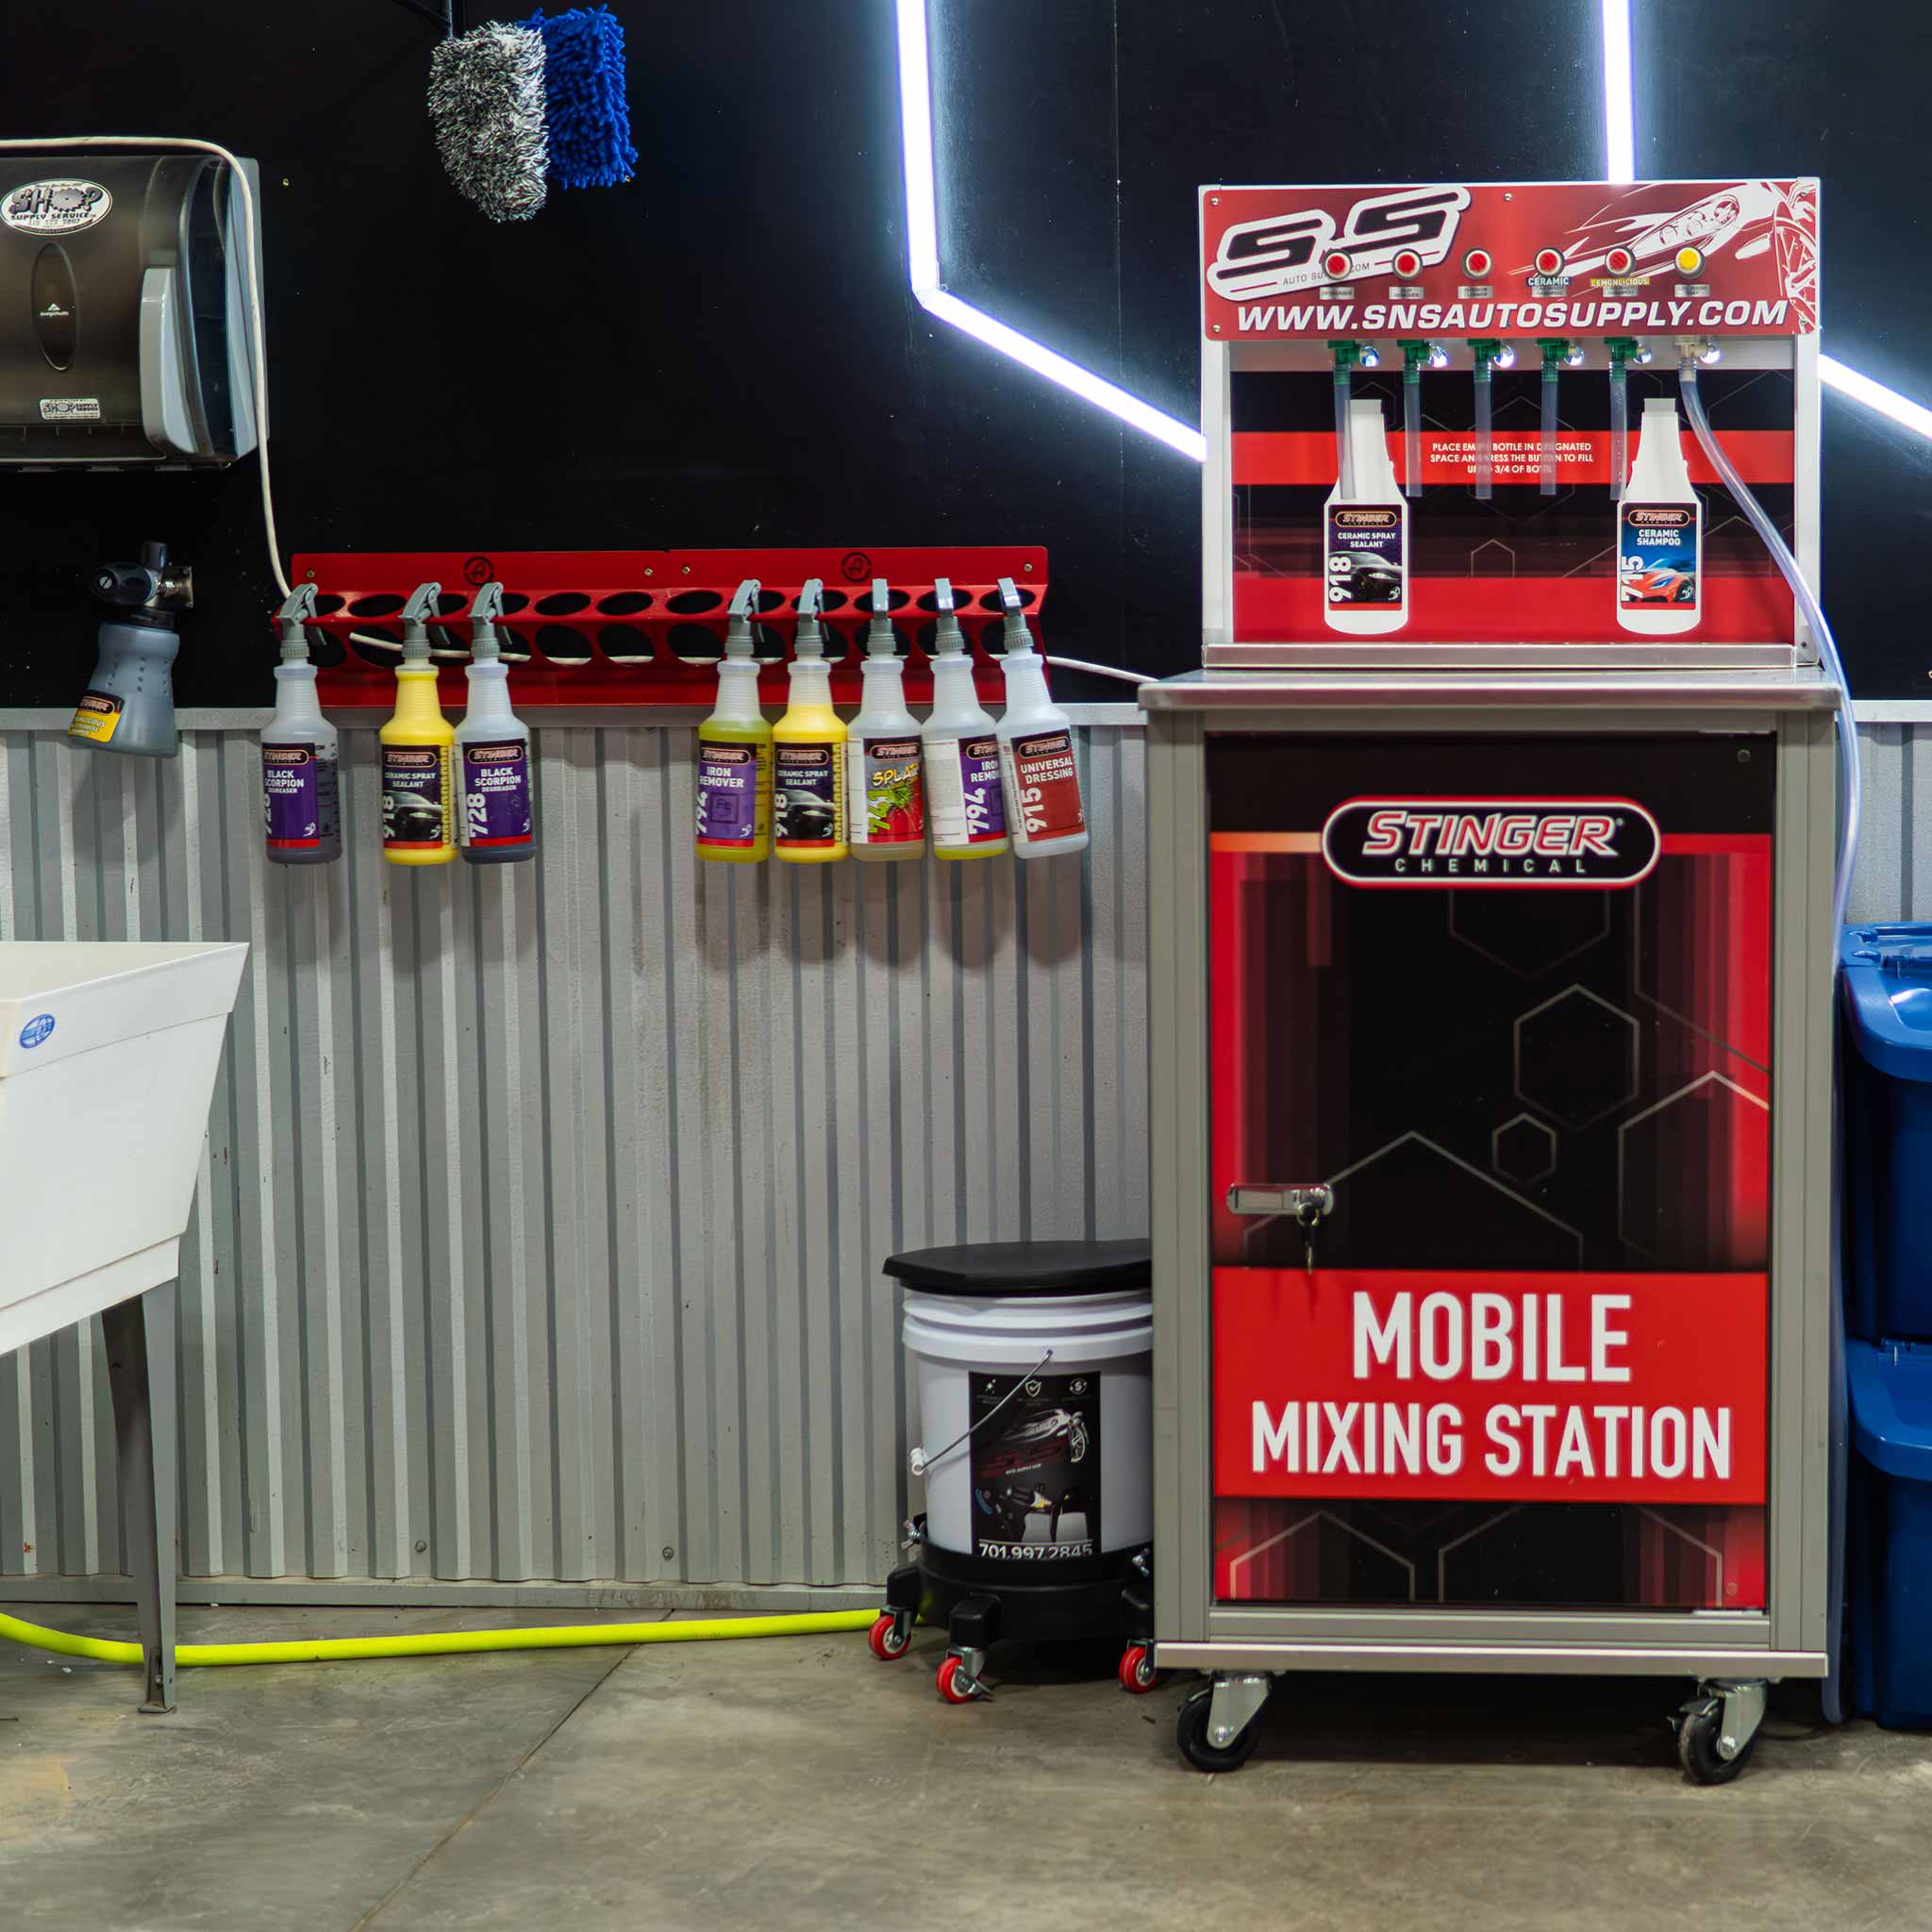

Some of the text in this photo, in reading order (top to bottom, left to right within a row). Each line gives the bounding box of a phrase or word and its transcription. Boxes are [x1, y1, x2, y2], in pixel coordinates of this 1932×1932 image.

[1283, 275, 1307, 286] AUTO
[1528, 277, 1569, 286] CERAMIC
[1591, 278, 1647, 287] LEMONLICIOUS
[1238, 300, 1789, 330] WWW.SNSAUTOSUPPLY.COM
[1432, 442, 1459, 452] PLACE
[1493, 442, 1522, 451] BOTTLE
[1524, 442, 1534, 451] IN
[1537, 442, 1591, 451] DGNATED
[1578, 454, 1593, 462] FILL
[1495, 465, 1509, 474] 3/4
[1511, 465, 1524, 474] OF
[1343, 513, 1390, 523] STINGER
[1636, 512, 1683, 522] STINGER
[1329, 557, 1351, 602] 918
[1621, 556, 1643, 602] 715
[1025, 739, 1067, 754] STINGER
[474, 749, 519, 759] STINGER
[1020, 756, 1073, 774] UNIVERSAL
[267, 770, 294, 778] BLACK
[480, 767, 513, 777] BLACK
[706, 766, 731, 777] IRON
[971, 770, 1000, 782] REMO
[1025, 767, 1073, 784] DRESSING
[264, 778, 304, 788] SCORPION
[475, 775, 522, 787] SCORPION
[699, 775, 744, 788] REMOVER
[467, 793, 489, 838] 728
[964, 788, 990, 834] 794
[1021, 788, 1047, 833] 915
[1361, 810, 1619, 857] STINGER
[1394, 858, 1587, 874] CHEMICAL
[1353, 1291, 1632, 1383] MOBILE
[1252, 1400, 1731, 1480] MIXING STATION
